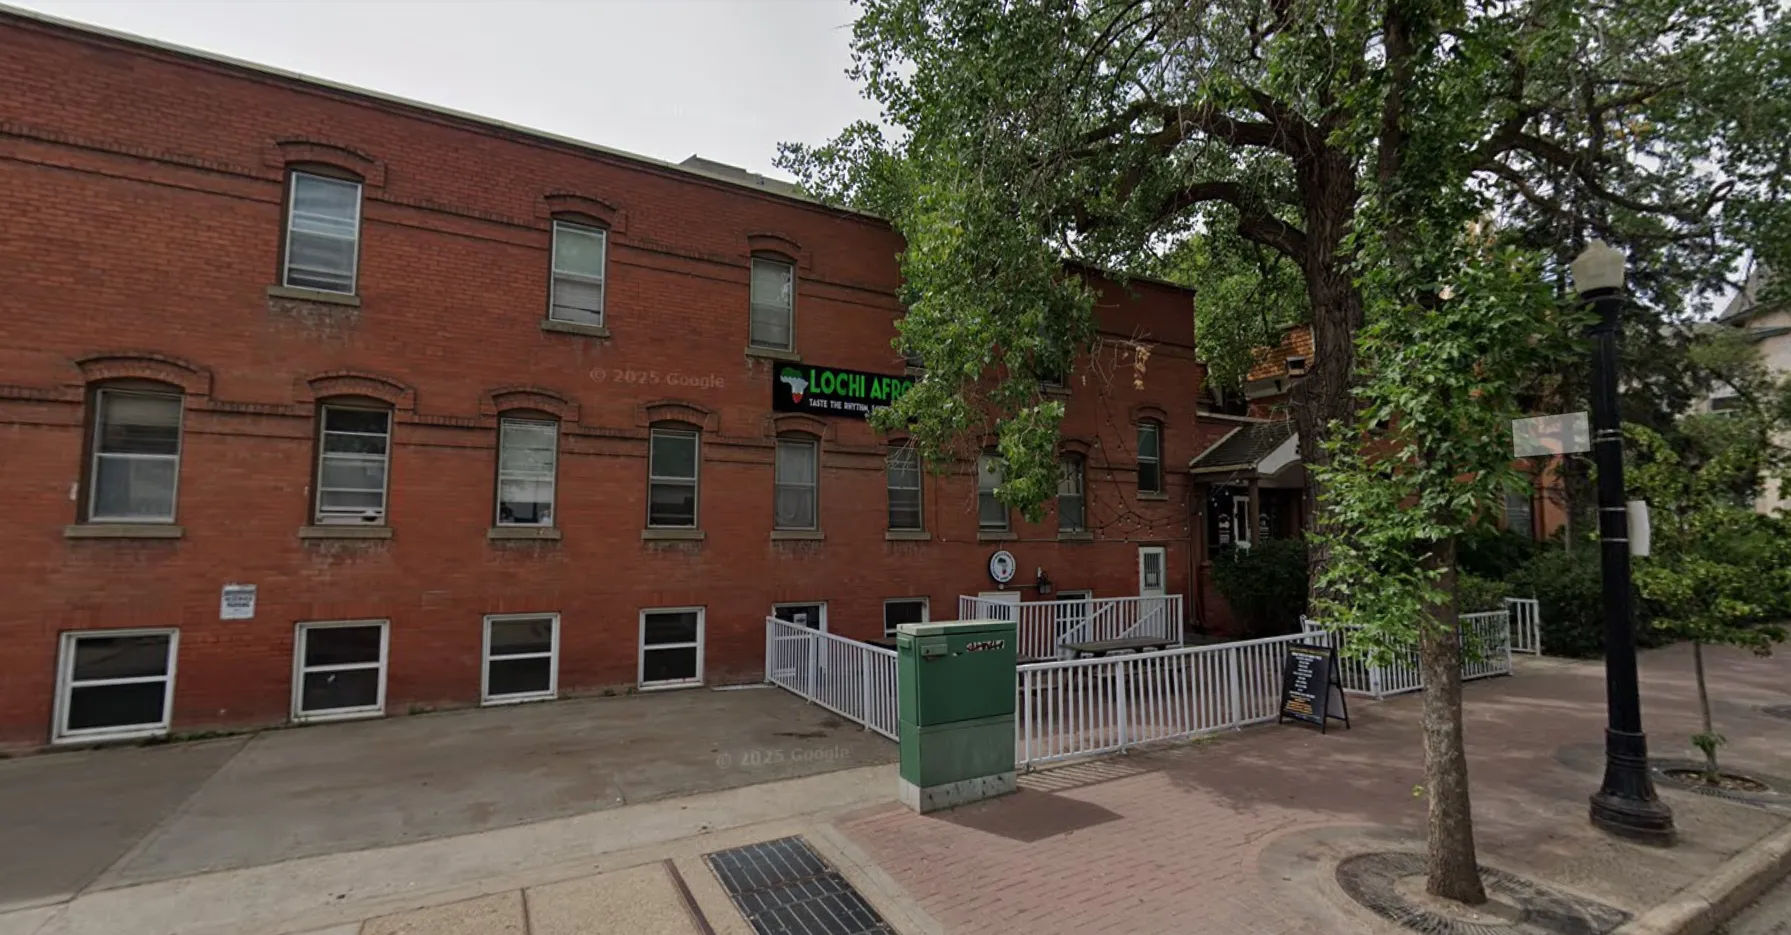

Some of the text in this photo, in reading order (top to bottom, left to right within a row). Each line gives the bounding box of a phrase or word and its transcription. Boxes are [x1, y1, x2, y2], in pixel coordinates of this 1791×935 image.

[810, 369, 865, 397] LOCHI
[809, 398, 828, 407] TASTE
[831, 401, 842, 410] THE
